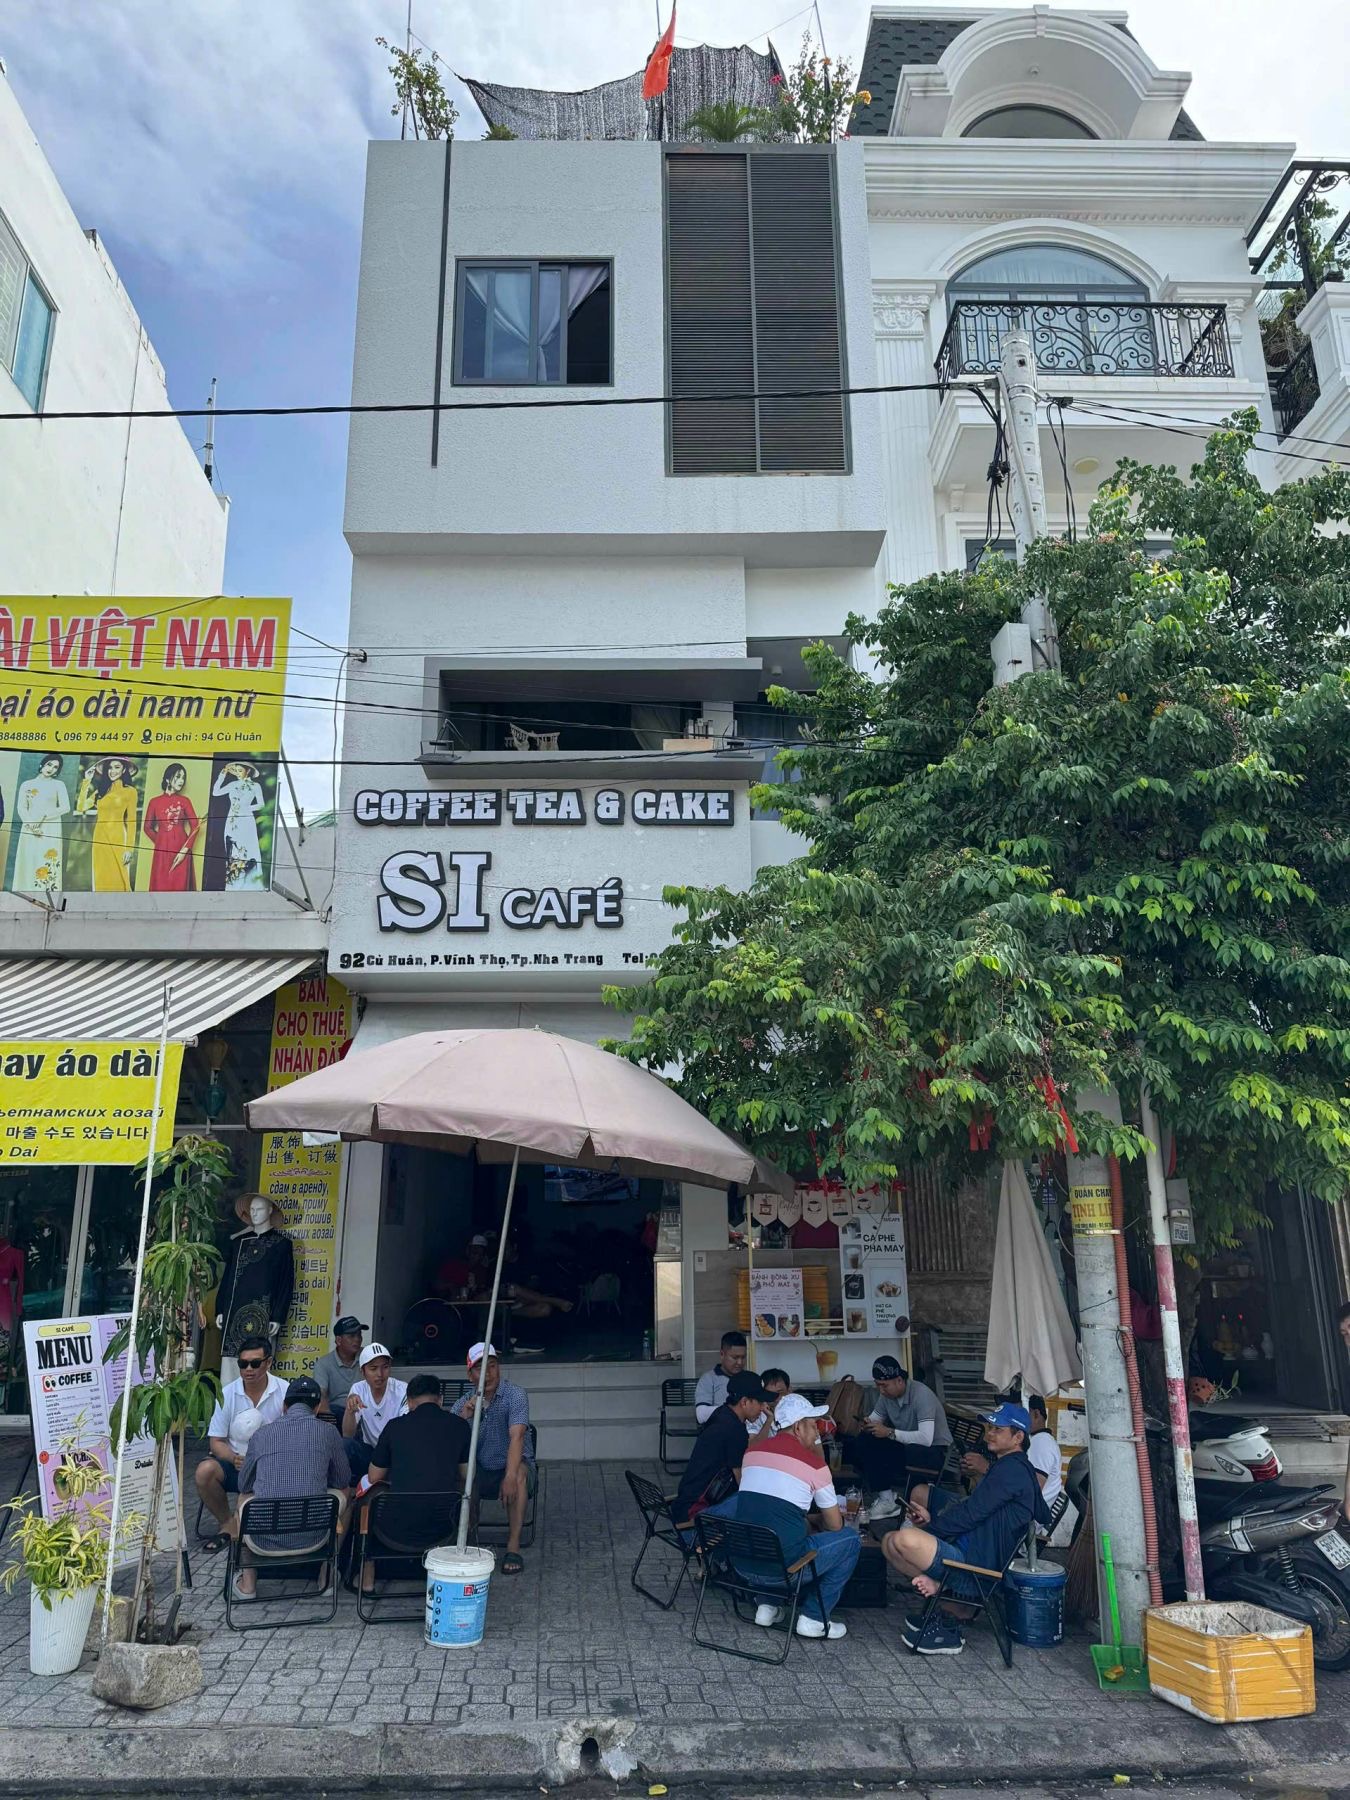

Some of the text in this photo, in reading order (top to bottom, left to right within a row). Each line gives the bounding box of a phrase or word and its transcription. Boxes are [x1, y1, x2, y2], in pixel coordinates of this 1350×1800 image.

[50, 608, 154, 679] VIỆT
[165, 619, 276, 667] NAM
[0, 689, 31, 723] ại
[37, 688, 74, 718] áo
[84, 689, 132, 717] dài
[138, 695, 203, 718] nam
[64, 732, 82, 741] 096
[86, 732, 97, 741] 79
[100, 732, 118, 741] 444
[122, 733, 133, 741] 97
[155, 732, 172, 743] Địa
[201, 732, 213, 741] 94
[354, 789, 734, 826] COFFEE TEA & CAKE
[377, 850, 624, 933] SI CAFÉ
[388, 954, 427, 967] Huân,
[564, 953, 603, 966] Trang
[277, 1005, 347, 1040] CHO THUÊ,
[0, 1053, 45, 1079] ay
[56, 1049, 97, 1076] áo
[45, 1127, 76, 1139] 수도
[83, 1126, 149, 1140] 있습니다
[9, 1146, 39, 1157] Dai
[270, 1180, 289, 1194] сдам
[1075, 1187, 1094, 1198] QUÁN
[302, 1199, 328, 1212] приму
[291, 1325, 329, 1339] 있습니다
[35, 1335, 93, 1369] MENU
[302, 1357, 319, 1370] Se
[58, 1372, 92, 1386] COFFEE
